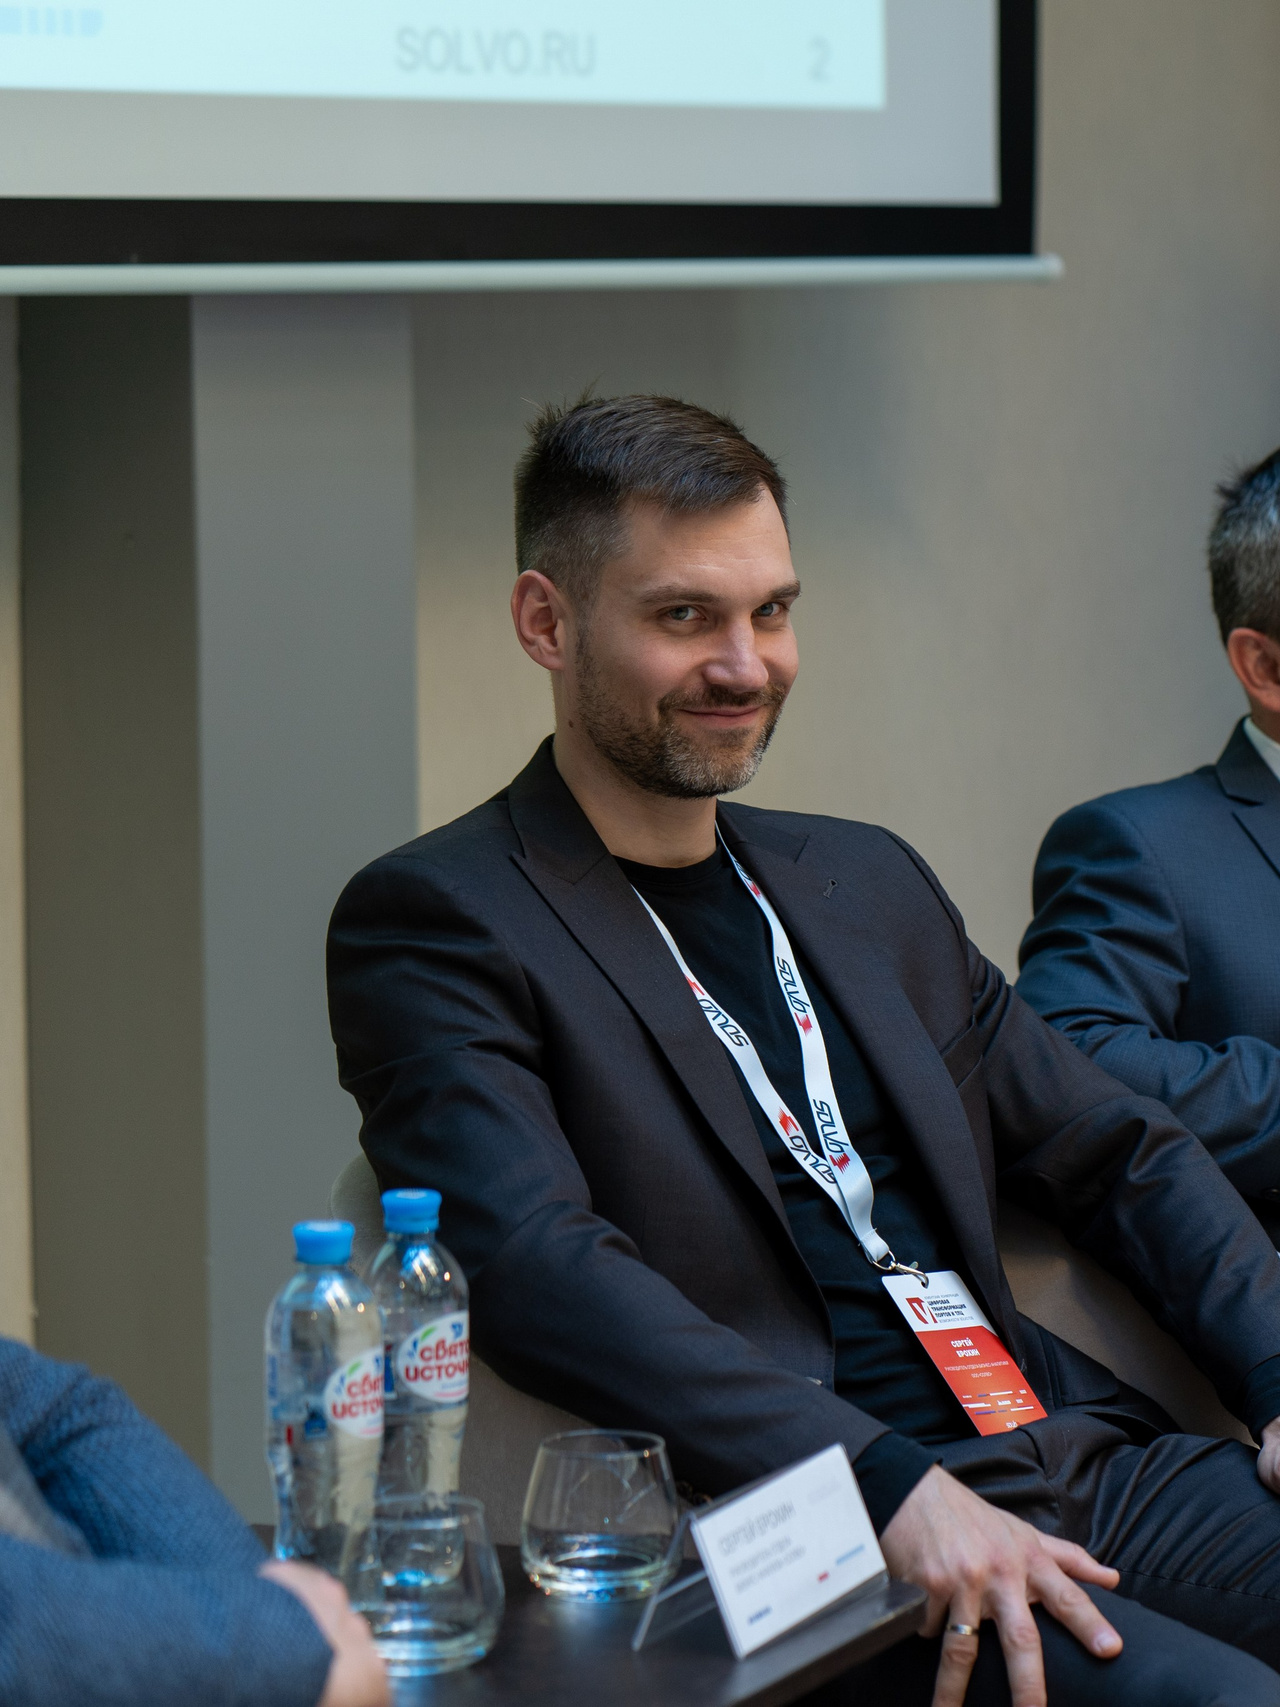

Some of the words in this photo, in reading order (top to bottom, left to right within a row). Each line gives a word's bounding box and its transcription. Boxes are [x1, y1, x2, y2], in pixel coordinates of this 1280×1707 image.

[395, 26, 597, 77] SOLVO.RU
[808, 35, 834, 83] 2
[777, 955, 809, 1013] SOLVO
[698, 998, 750, 1047] SOLVO
[813, 1098, 848, 1155] SOLVO
